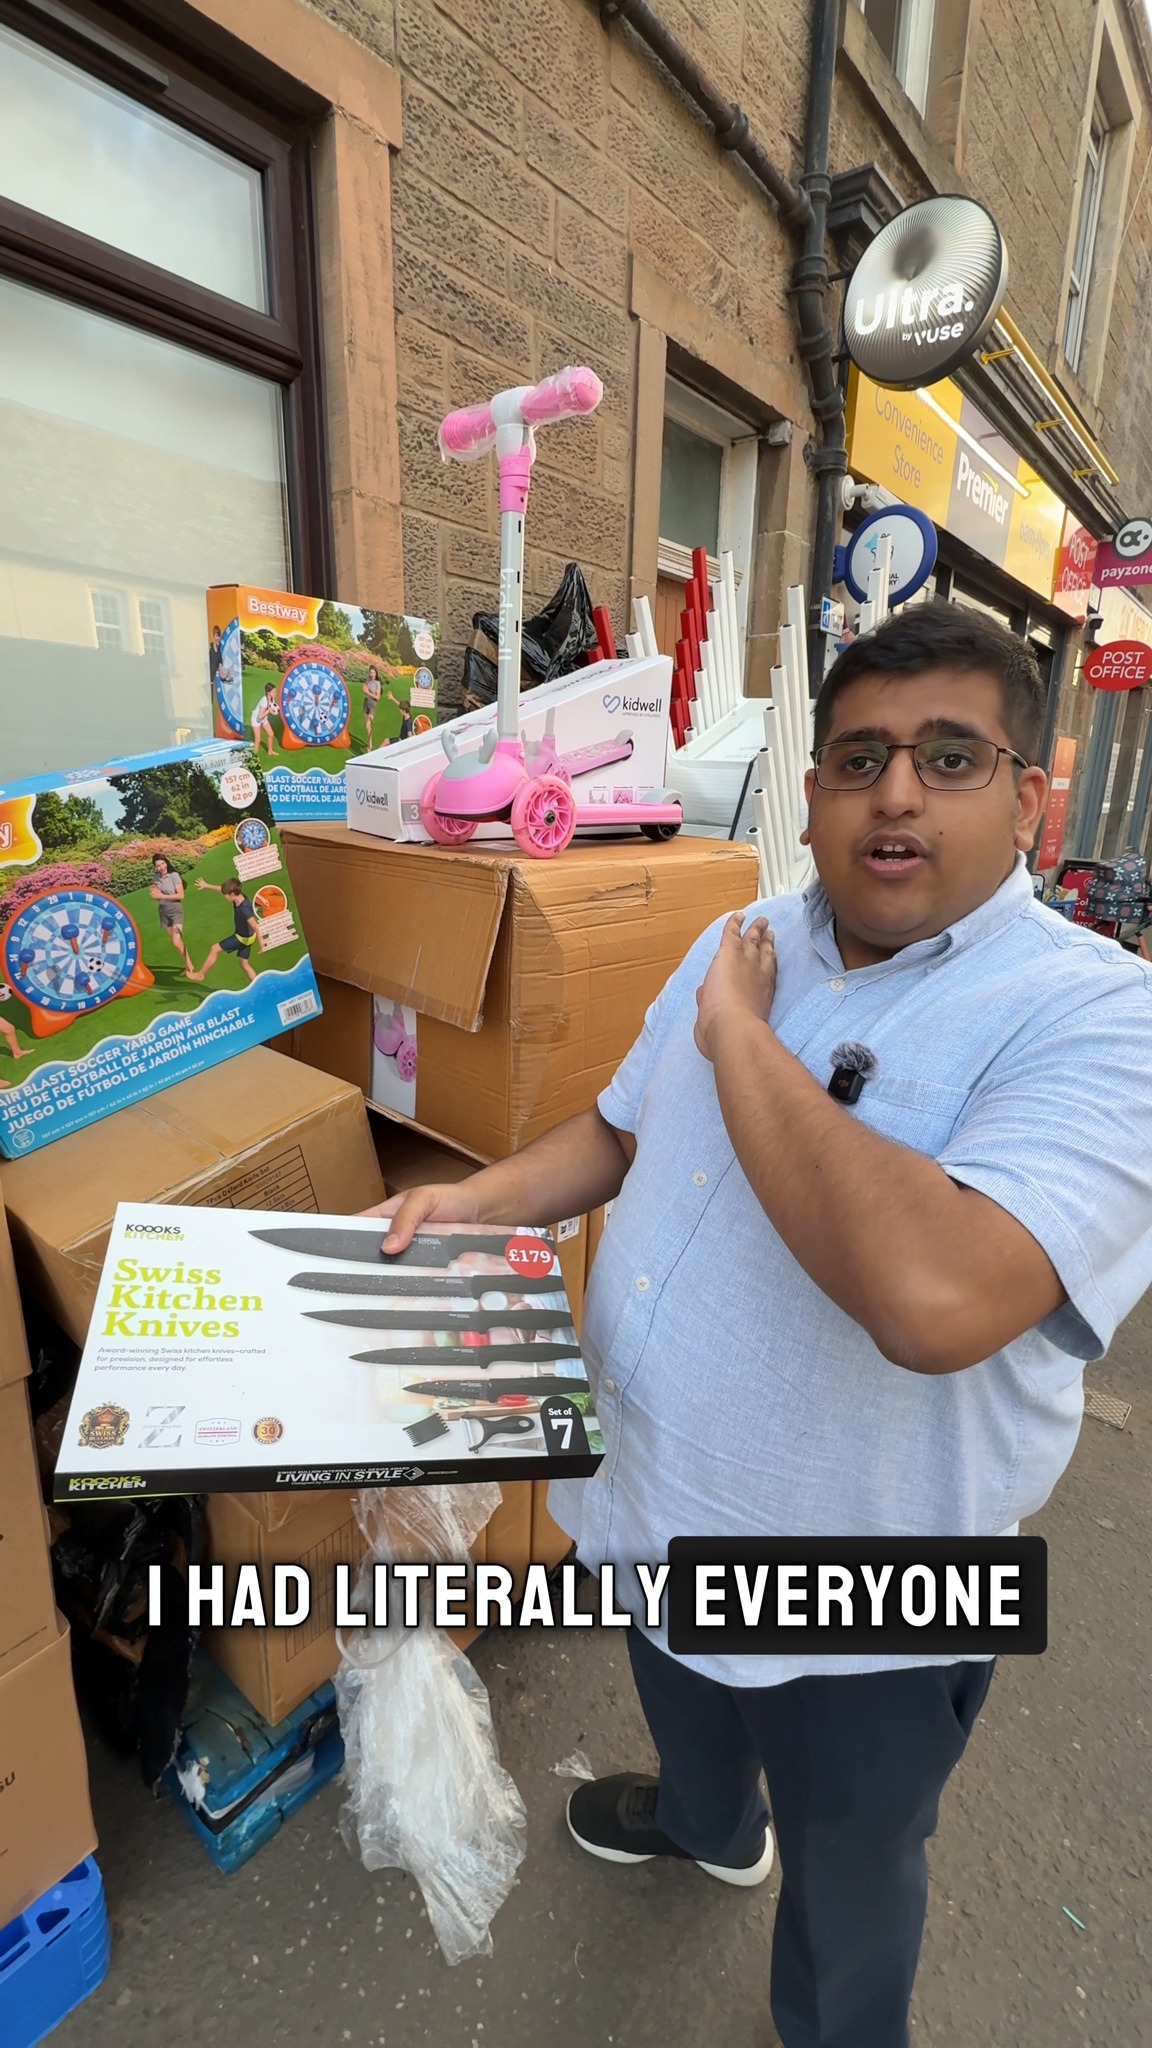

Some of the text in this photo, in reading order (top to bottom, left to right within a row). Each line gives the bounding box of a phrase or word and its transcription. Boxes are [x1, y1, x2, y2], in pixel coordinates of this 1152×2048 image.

[902, 332, 912, 342] by
[875, 385, 944, 464] Convenience
[893, 444, 921, 489] Store
[956, 451, 1009, 526] Premier
[1068, 533, 1090, 571] POST
[1061, 566, 1087, 606] OFFICE
[248, 596, 308, 625] Bestway
[1102, 651, 1144, 665] POST
[1090, 665, 1147, 679] OFFICE
[622, 696, 662, 712] kidwell
[225, 773, 250, 784] 157 cm
[266, 775, 342, 785] BLAST SOCCER YARD
[231, 782, 249, 793] 62 in
[268, 785, 278, 793] DE
[280, 785, 318, 794] FOOTBALL
[232, 791, 253, 802] 62 po
[281, 795, 291, 803] DE
[292, 791, 321, 803] FÚTBOL
[322, 795, 332, 803] DE
[365, 789, 388, 807] kidwell
[410, 804, 420, 820] 3
[48, 895, 58, 903] 20
[32, 905, 40, 913] 5
[18, 918, 29, 928] 12
[23, 1070, 66, 1097] BLAST
[69, 1047, 120, 1077] SOCCER
[123, 1032, 157, 1053] YARD
[158, 1016, 193, 1037] GAME
[2, 1006, 241, 1121] JEU DE FOOTBALL DE JARDIN AIR BLAST
[7, 1106, 55, 1134] JUEGO
[56, 1096, 76, 1111] DE
[78, 1075, 129, 1104] FÚTBOL
[128, 1062, 147, 1076] DE
[148, 1043, 193, 1070] JARDÍN
[193, 1014, 255, 1049] HINCHABLE
[222, 1181, 243, 1196] Oxford
[244, 1172, 260, 1185] Knife
[260, 1166, 270, 1175] Set
[264, 1184, 280, 1197] Black
[125, 1224, 181, 1234] KOOOKS
[124, 1231, 185, 1241] KITCHEN
[508, 1248, 551, 1264] £179
[113, 1257, 221, 1285] Swiss
[107, 1284, 263, 1312] Kitchen
[101, 1311, 240, 1338] Knives
[148, 1355, 184, 1363] designed
[94, 1364, 146, 1372] performance
[171, 1364, 187, 1372] day.
[548, 1407, 572, 1416] Set of
[261, 1426, 275, 1434] 30
[550, 1418, 573, 1449] 7
[70, 1475, 142, 1486] KOOOKS
[276, 1470, 404, 1483] LIVING IN STYLE
[69, 1480, 146, 1491] KITCHEN
